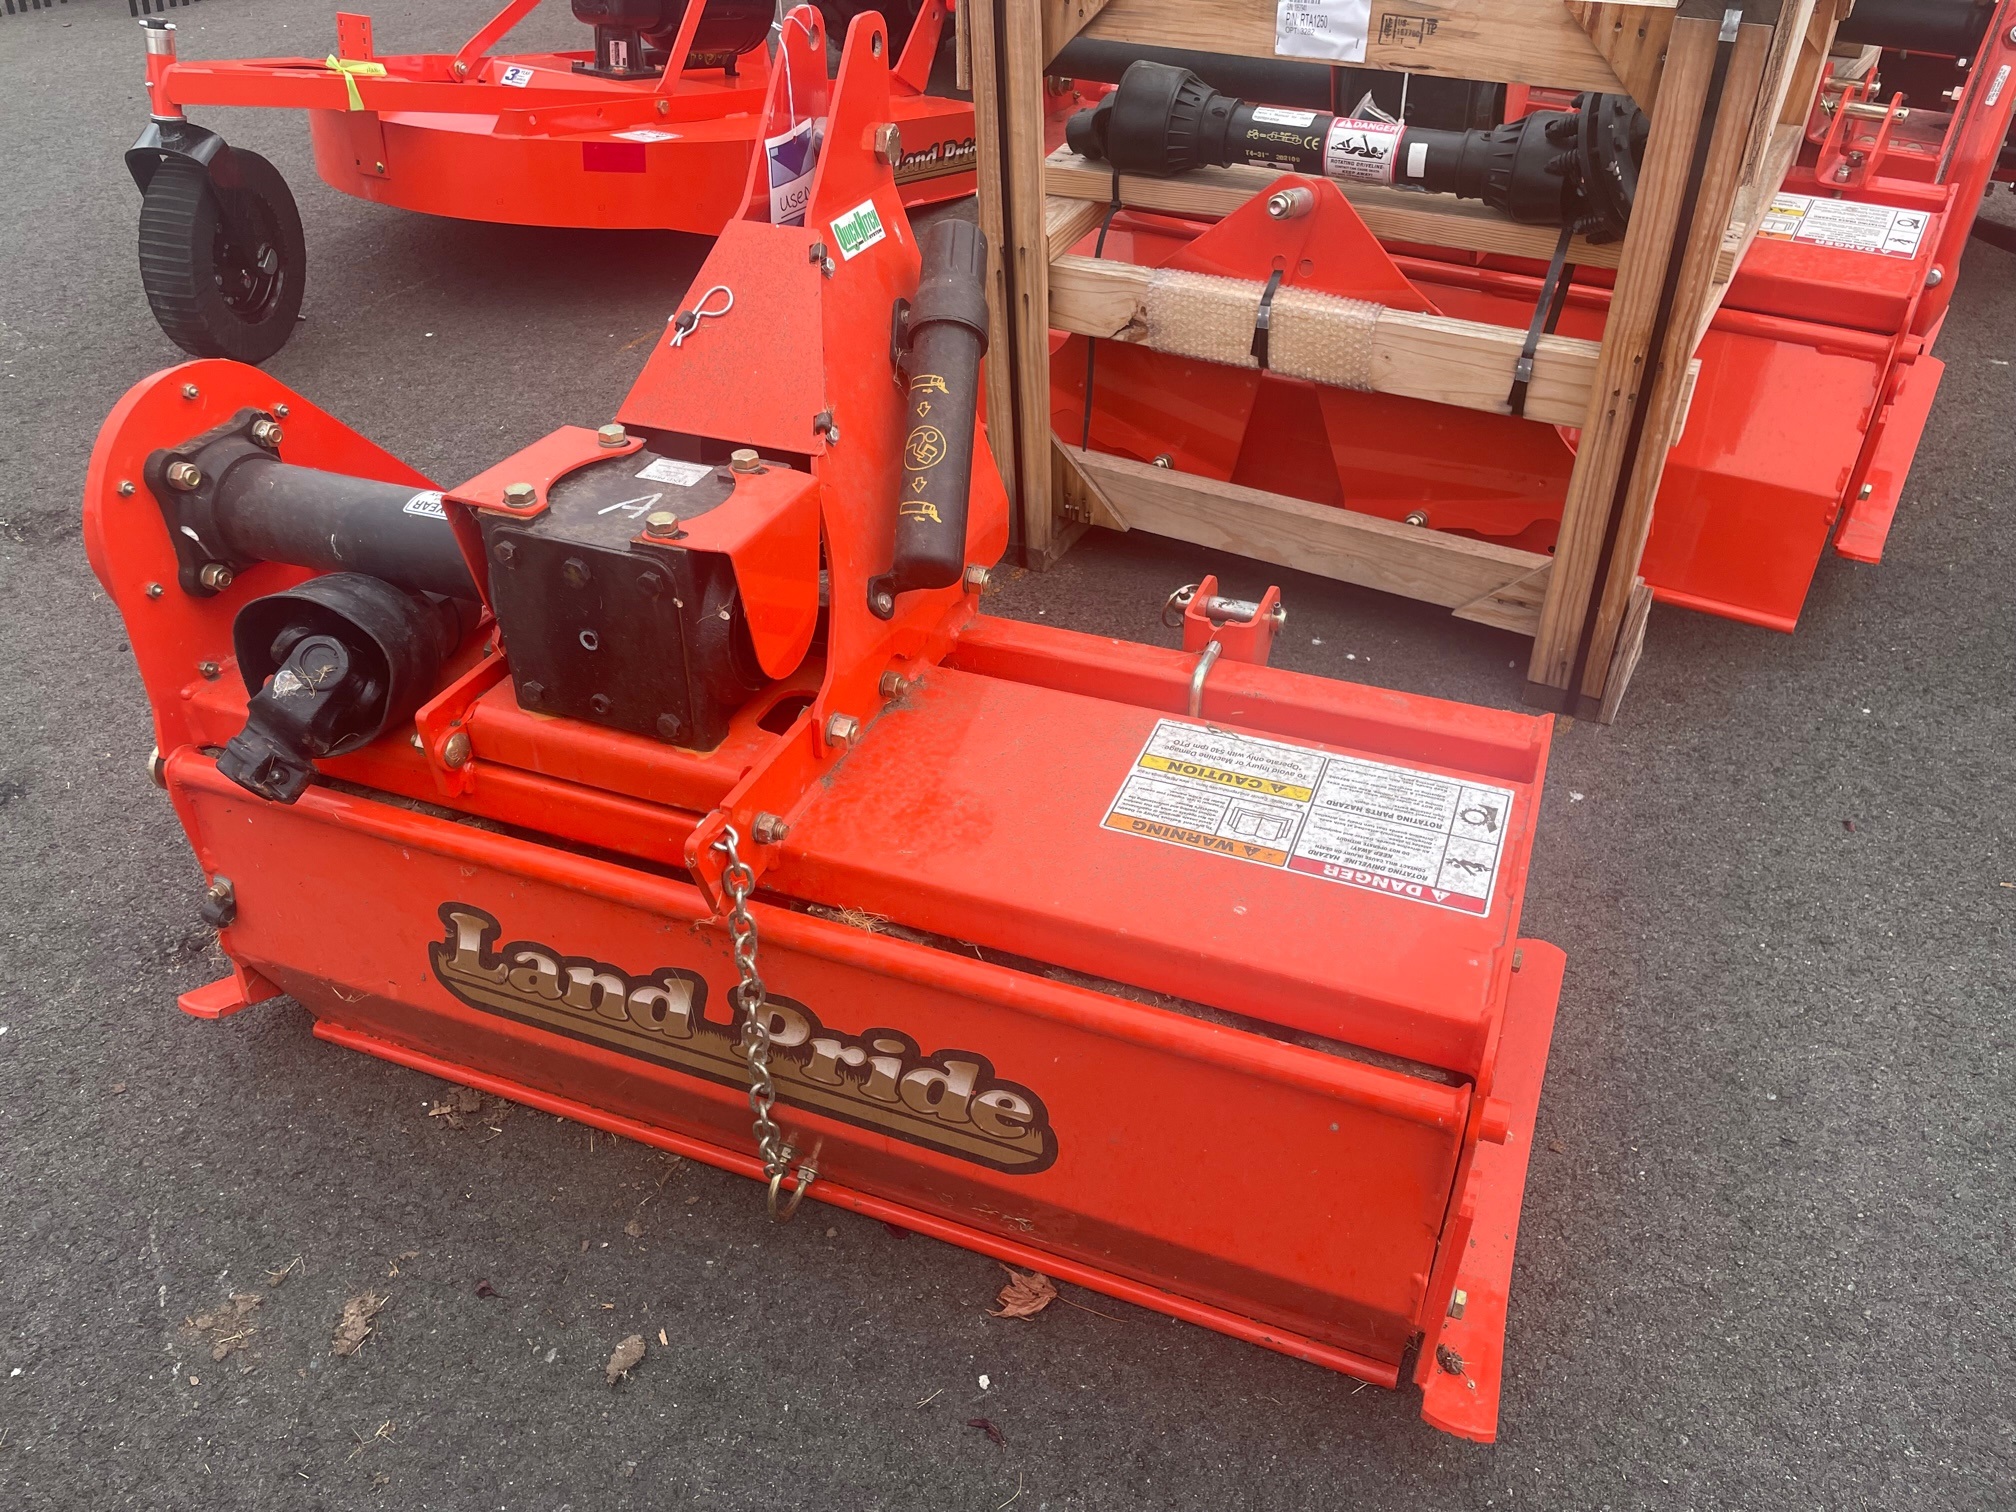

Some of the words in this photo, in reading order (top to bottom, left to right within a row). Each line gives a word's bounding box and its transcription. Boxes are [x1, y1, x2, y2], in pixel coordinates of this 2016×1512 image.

[1300, 13, 1328, 28] RTA1250
[505, 68, 520, 82] 3
[1304, 136, 1320, 150] CE
[1171, 738, 1191, 747] PTO
[1191, 742, 1209, 751] rpm
[1209, 746, 1225, 754] 540
[1225, 749, 1244, 758] with
[1197, 751, 1233, 764] Machine
[1245, 753, 1264, 762] only
[1245, 761, 1270, 771] Injury
[1271, 766, 1295, 776] avoid
[1166, 761, 1263, 788] CAUTION
[1325, 799, 1362, 812] HAZARD
[1364, 807, 1394, 818] PARTS
[1396, 814, 1442, 829] ROTATING
[1130, 820, 1235, 851] WARNING
[1307, 849, 1340, 861] HAZARD
[1349, 845, 1372, 854] AWAY!
[1373, 850, 1393, 858] KEEP
[1343, 857, 1386, 871] DRIVELINE
[1322, 864, 1422, 896] DANGER
[1387, 867, 1428, 881] ROTATING
[442, 908, 699, 1040] Land
[732, 998, 1038, 1140] Pride
